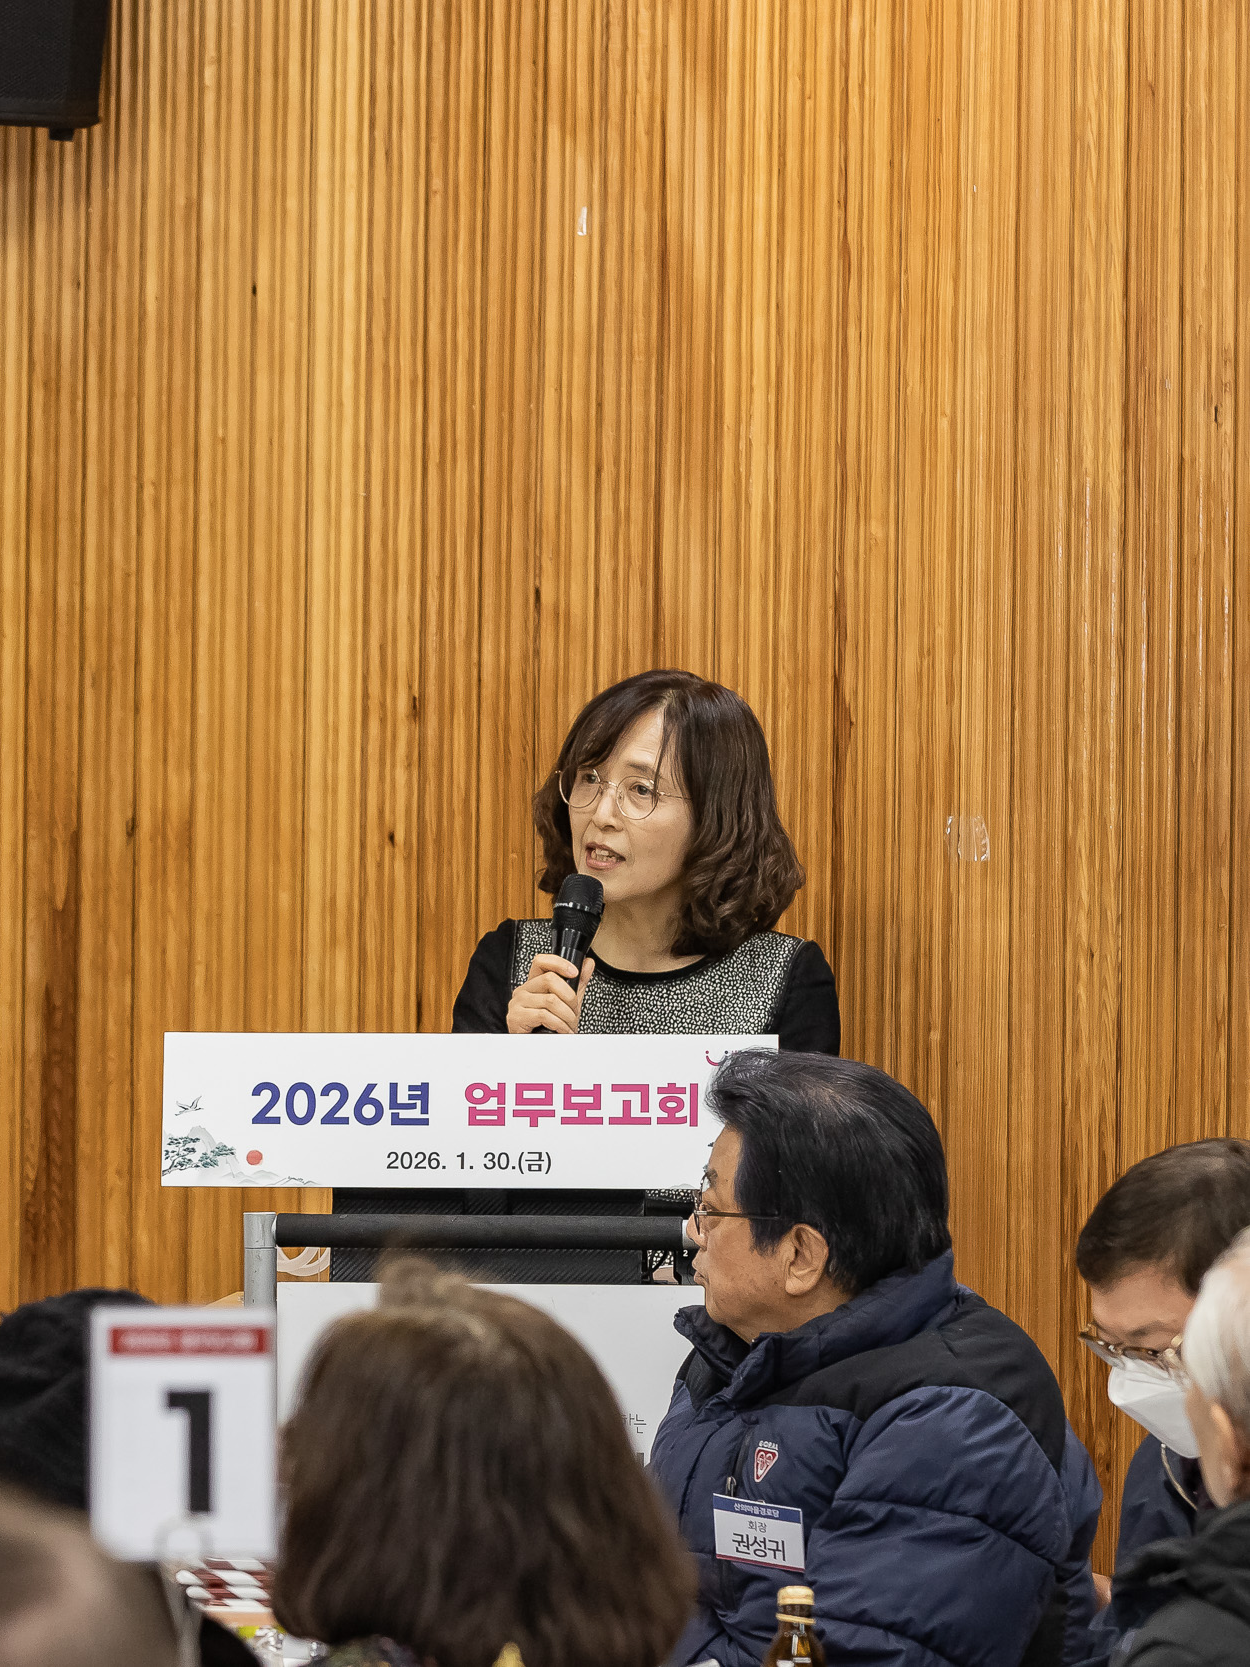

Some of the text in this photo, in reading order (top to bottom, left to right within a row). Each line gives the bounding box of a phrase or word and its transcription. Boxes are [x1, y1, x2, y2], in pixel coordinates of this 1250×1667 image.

[250, 1081, 699, 1128] 2026년 업무보고회
[386, 1151, 552, 1174] 2026. 1. 30.(금)
[166, 1390, 212, 1514] 1
[748, 1520, 767, 1533] 회장
[732, 1532, 786, 1562] 권성귀
